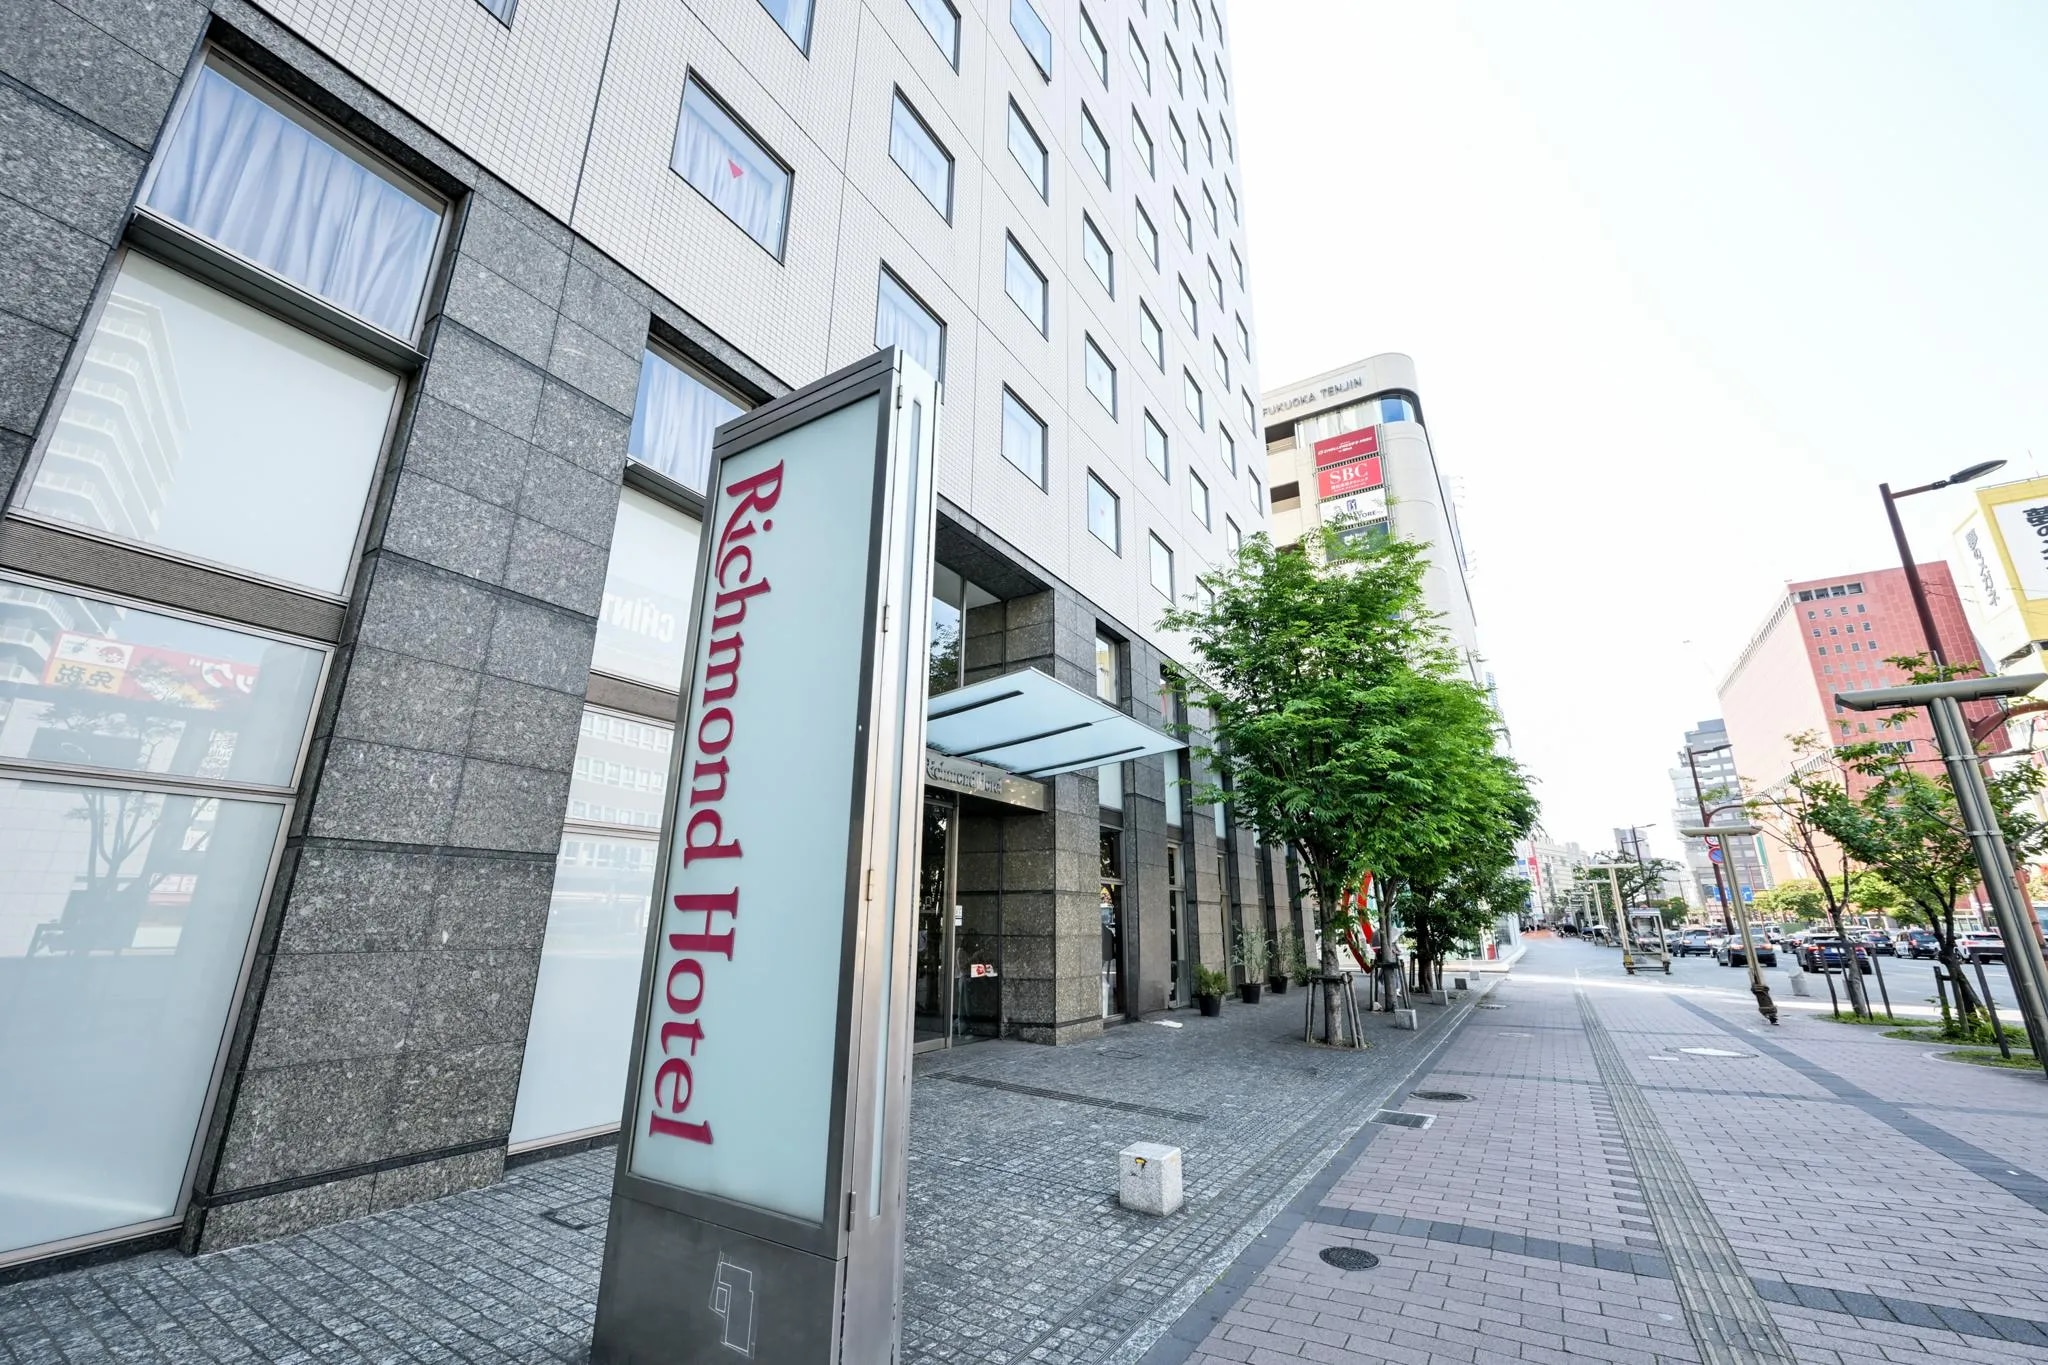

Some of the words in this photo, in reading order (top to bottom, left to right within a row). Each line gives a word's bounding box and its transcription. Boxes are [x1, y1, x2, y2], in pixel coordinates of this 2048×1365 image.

[1262, 392, 1317, 417] FUKUOKA
[1319, 376, 1363, 399] TENJIN
[1330, 462, 1369, 485] SBC
[684, 459, 784, 869] Richmond
[649, 886, 740, 1145] Hotel
